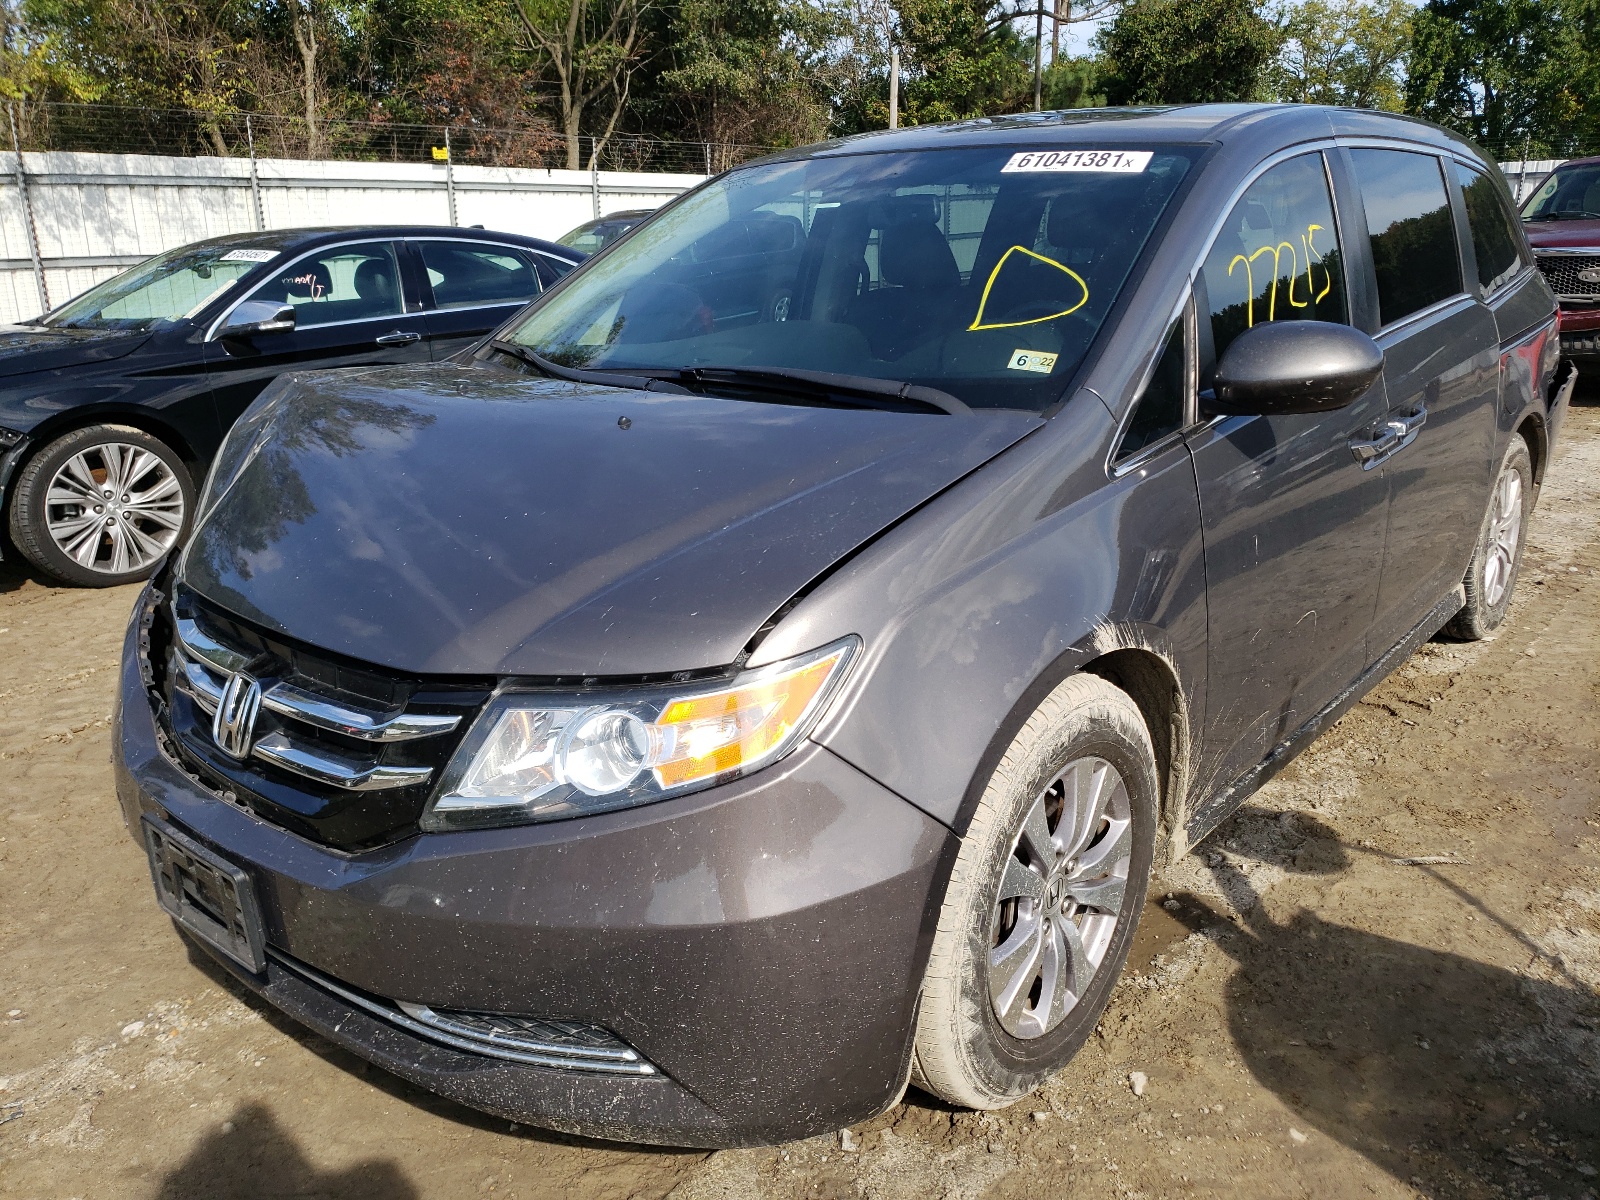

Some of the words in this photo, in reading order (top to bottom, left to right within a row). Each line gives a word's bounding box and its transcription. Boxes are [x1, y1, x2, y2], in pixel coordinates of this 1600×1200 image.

[1017, 152, 1125, 168] 61041381
[1016, 354, 1029, 367] 6
[1039, 357, 1054, 367] 22
